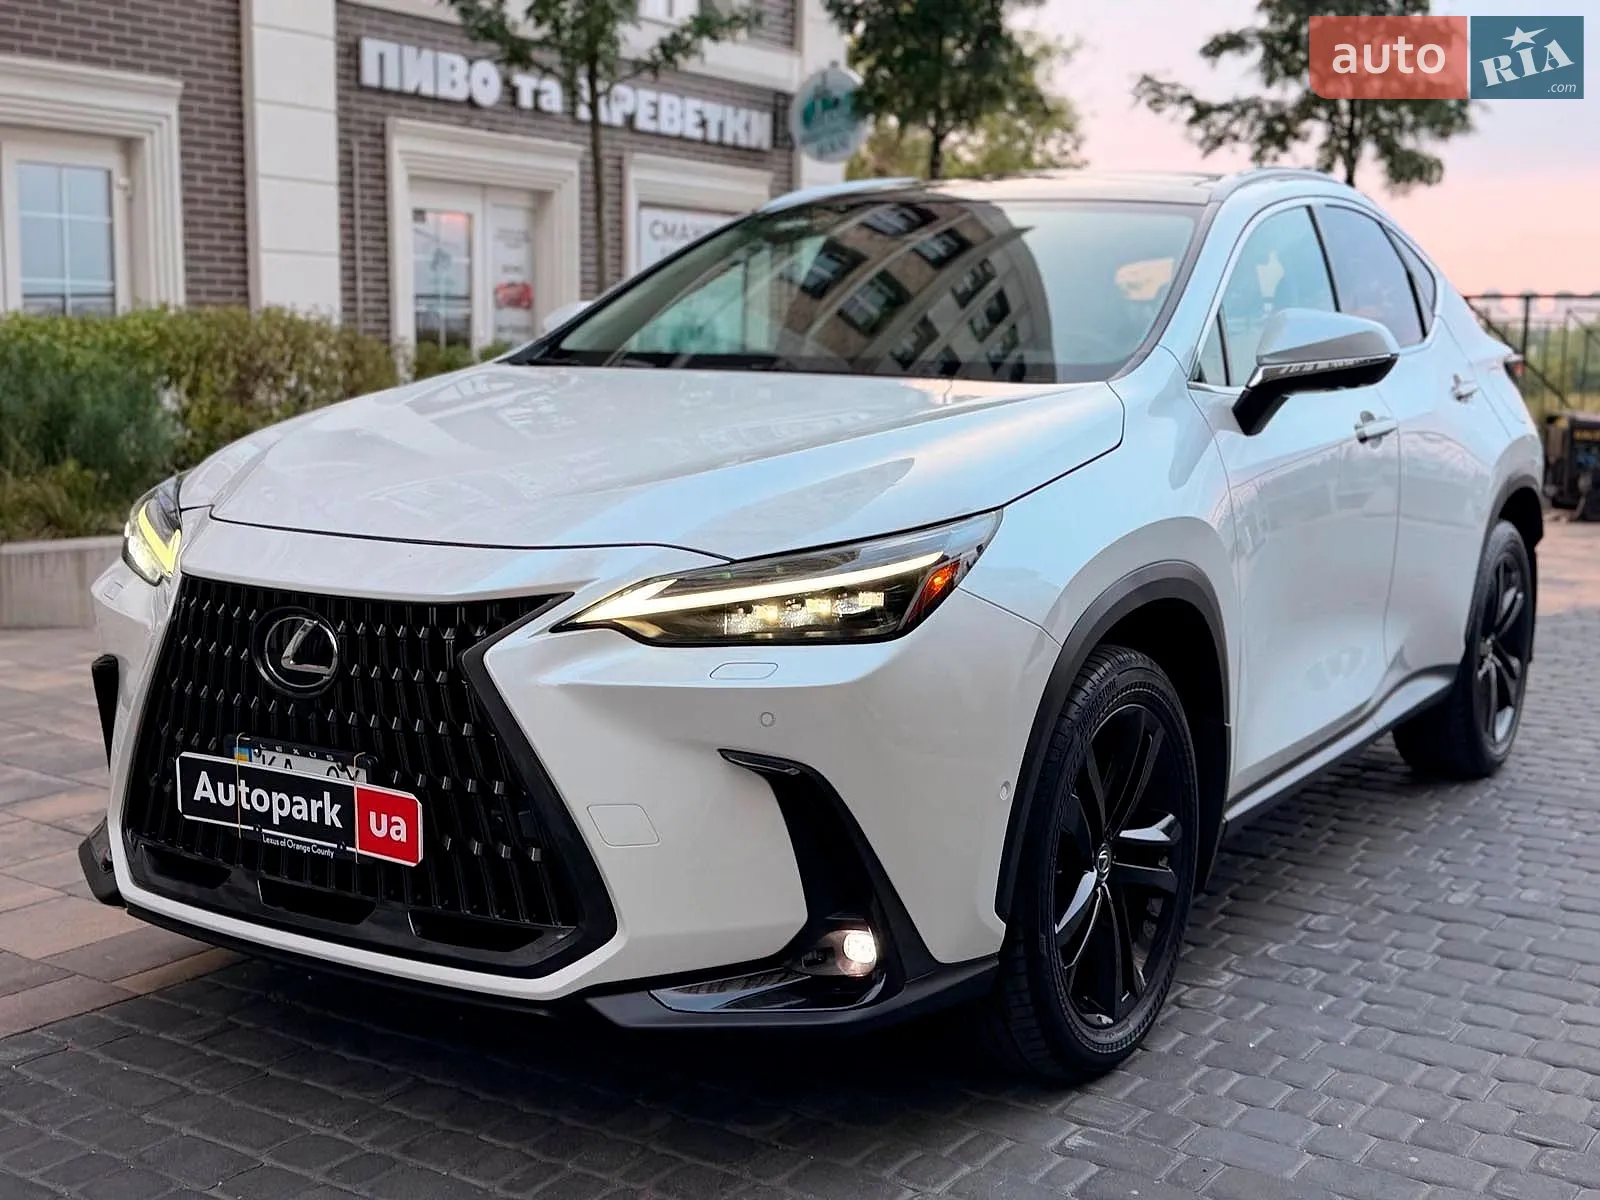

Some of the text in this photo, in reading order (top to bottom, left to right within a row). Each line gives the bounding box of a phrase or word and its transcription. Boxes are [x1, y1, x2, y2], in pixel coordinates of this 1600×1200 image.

[360, 37, 501, 107] ПИВО
[511, 71, 564, 114] та
[192, 770, 407, 842] Autopark ua
[262, 833, 280, 846] Lexus
[286, 839, 311, 854] Orange
[311, 844, 335, 859] County
